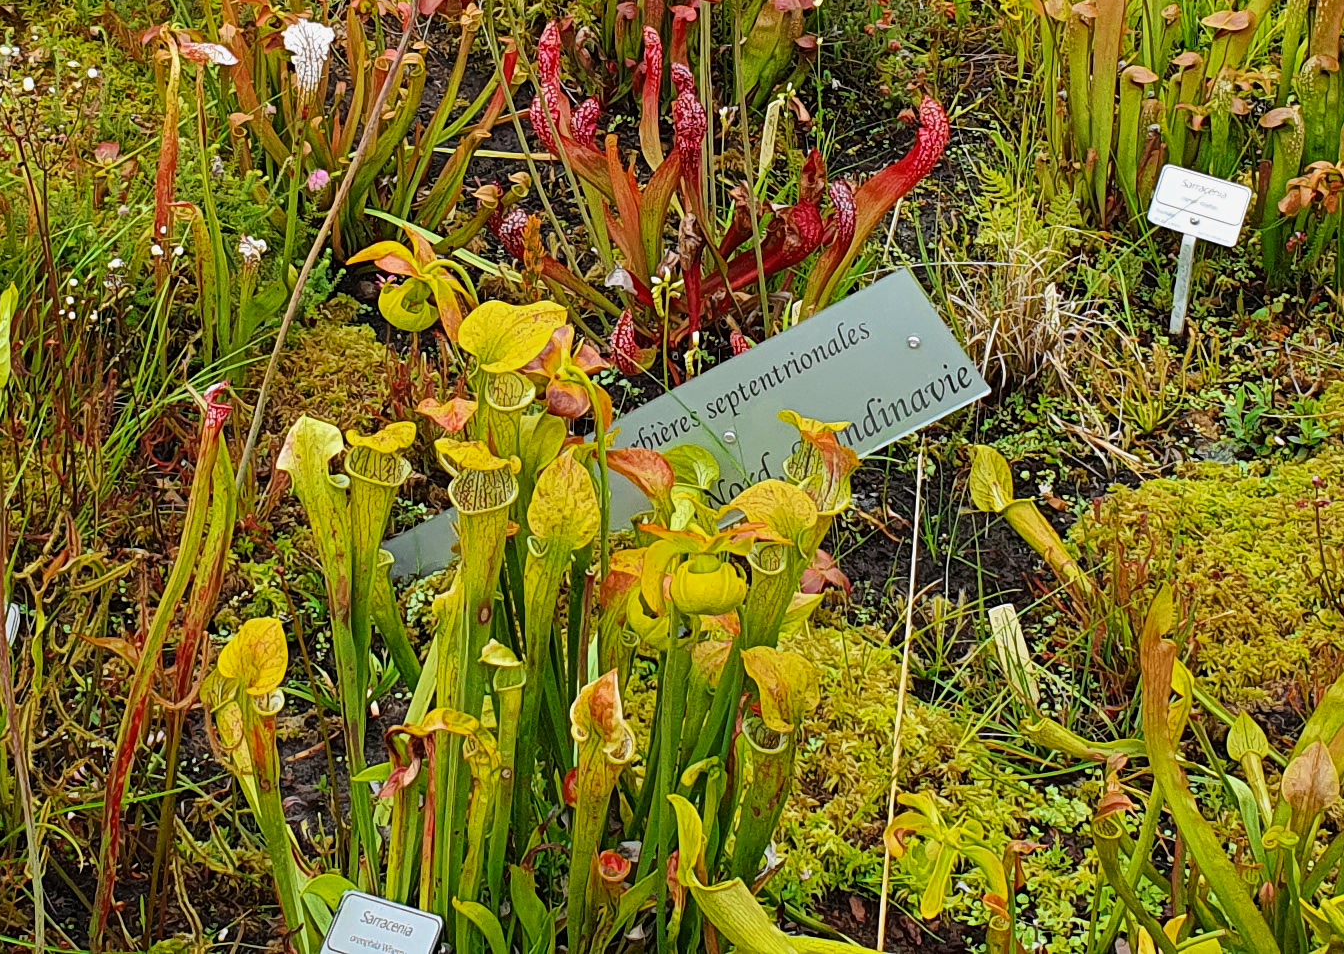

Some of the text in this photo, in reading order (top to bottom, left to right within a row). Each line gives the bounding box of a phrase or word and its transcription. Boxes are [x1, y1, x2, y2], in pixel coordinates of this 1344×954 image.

[629, 320, 871, 451] rbières septentrionales
[792, 363, 975, 453] ndinavie
[359, 910, 414, 937] Sarracenia
